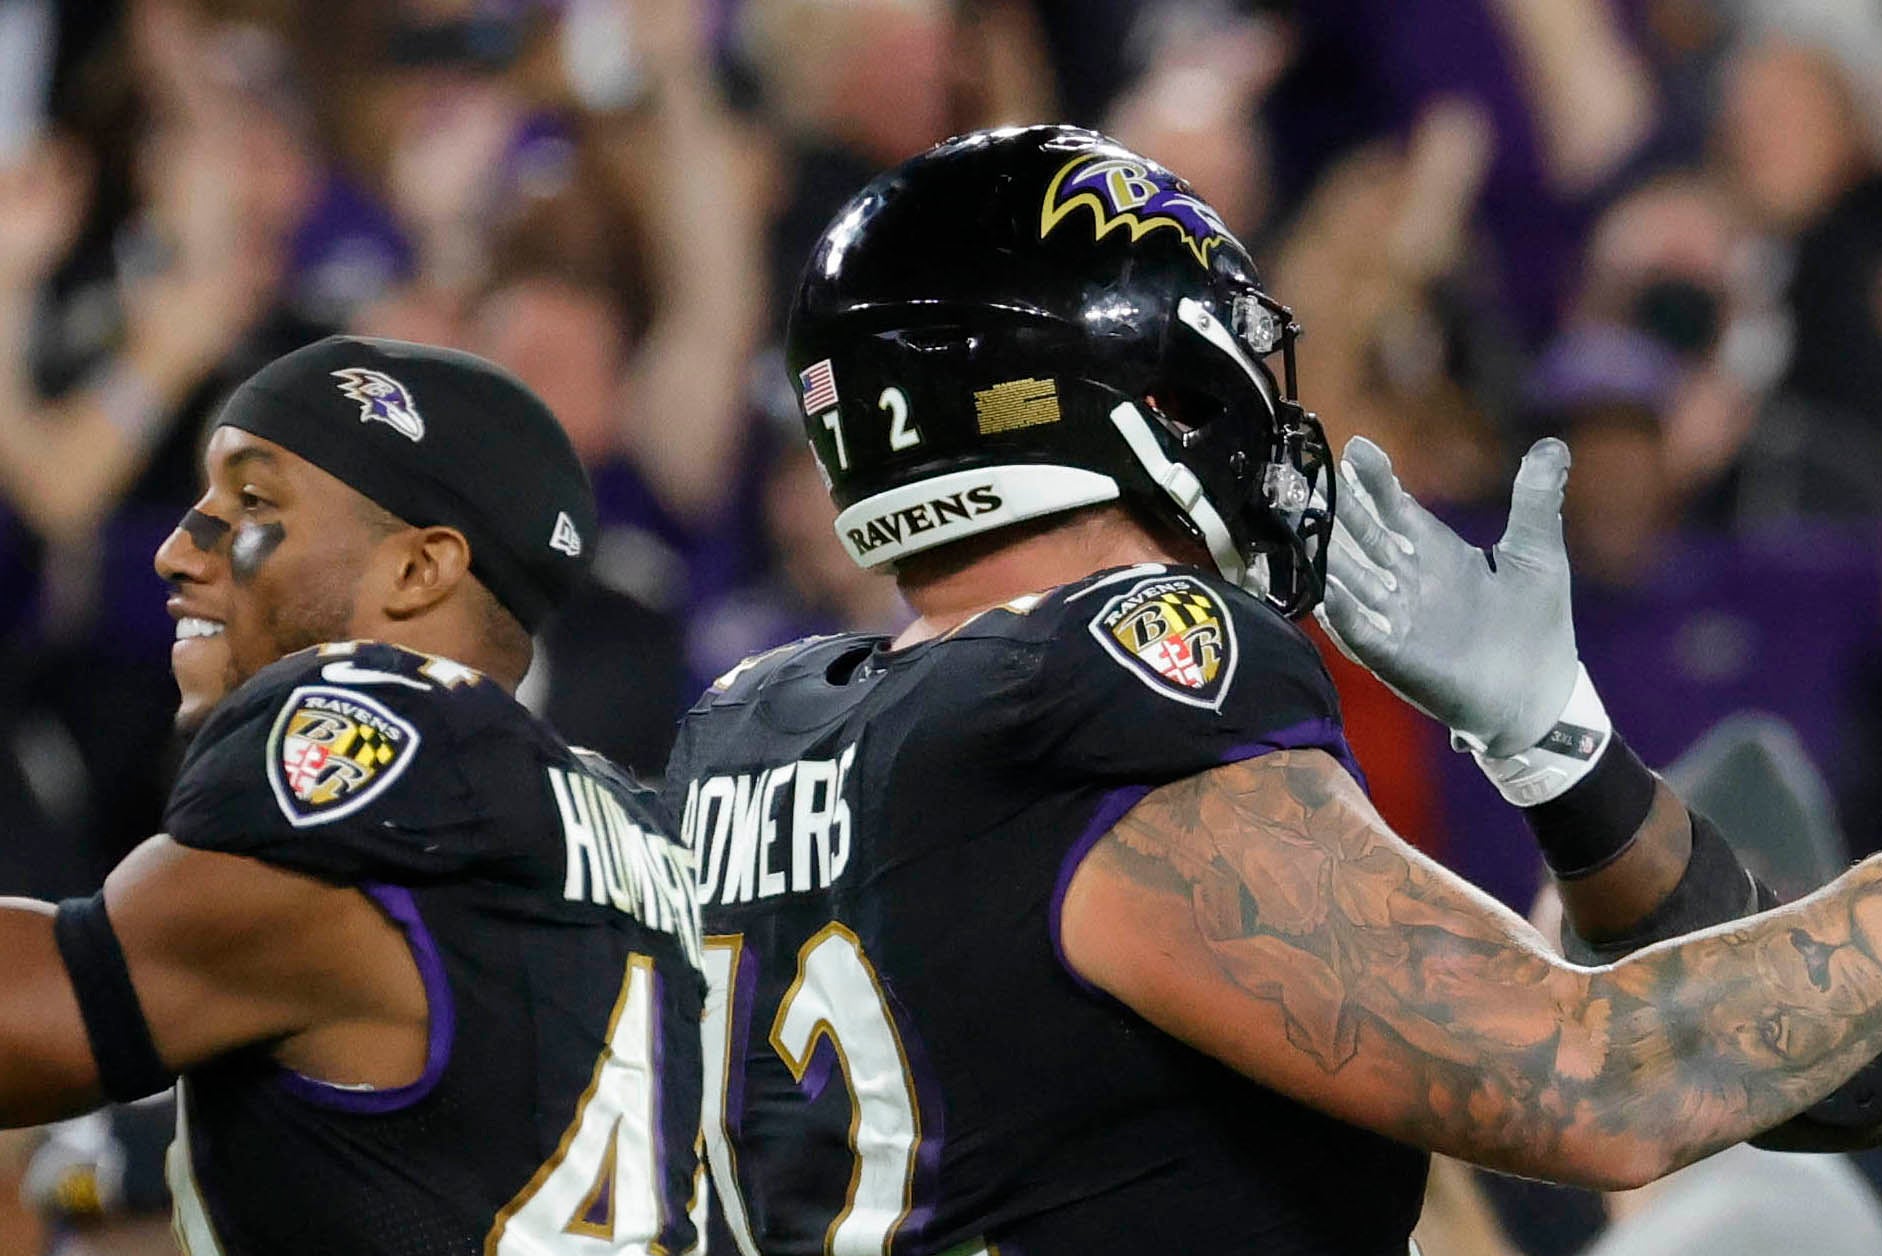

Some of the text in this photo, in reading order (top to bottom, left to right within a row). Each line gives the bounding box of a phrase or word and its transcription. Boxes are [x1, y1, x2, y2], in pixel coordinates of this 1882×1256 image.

[846, 484, 1003, 556] RAVENS
[1103, 581, 1191, 627] RAVENS
[304, 696, 402, 741] RAVENS
[680, 742, 857, 905] POWERS
